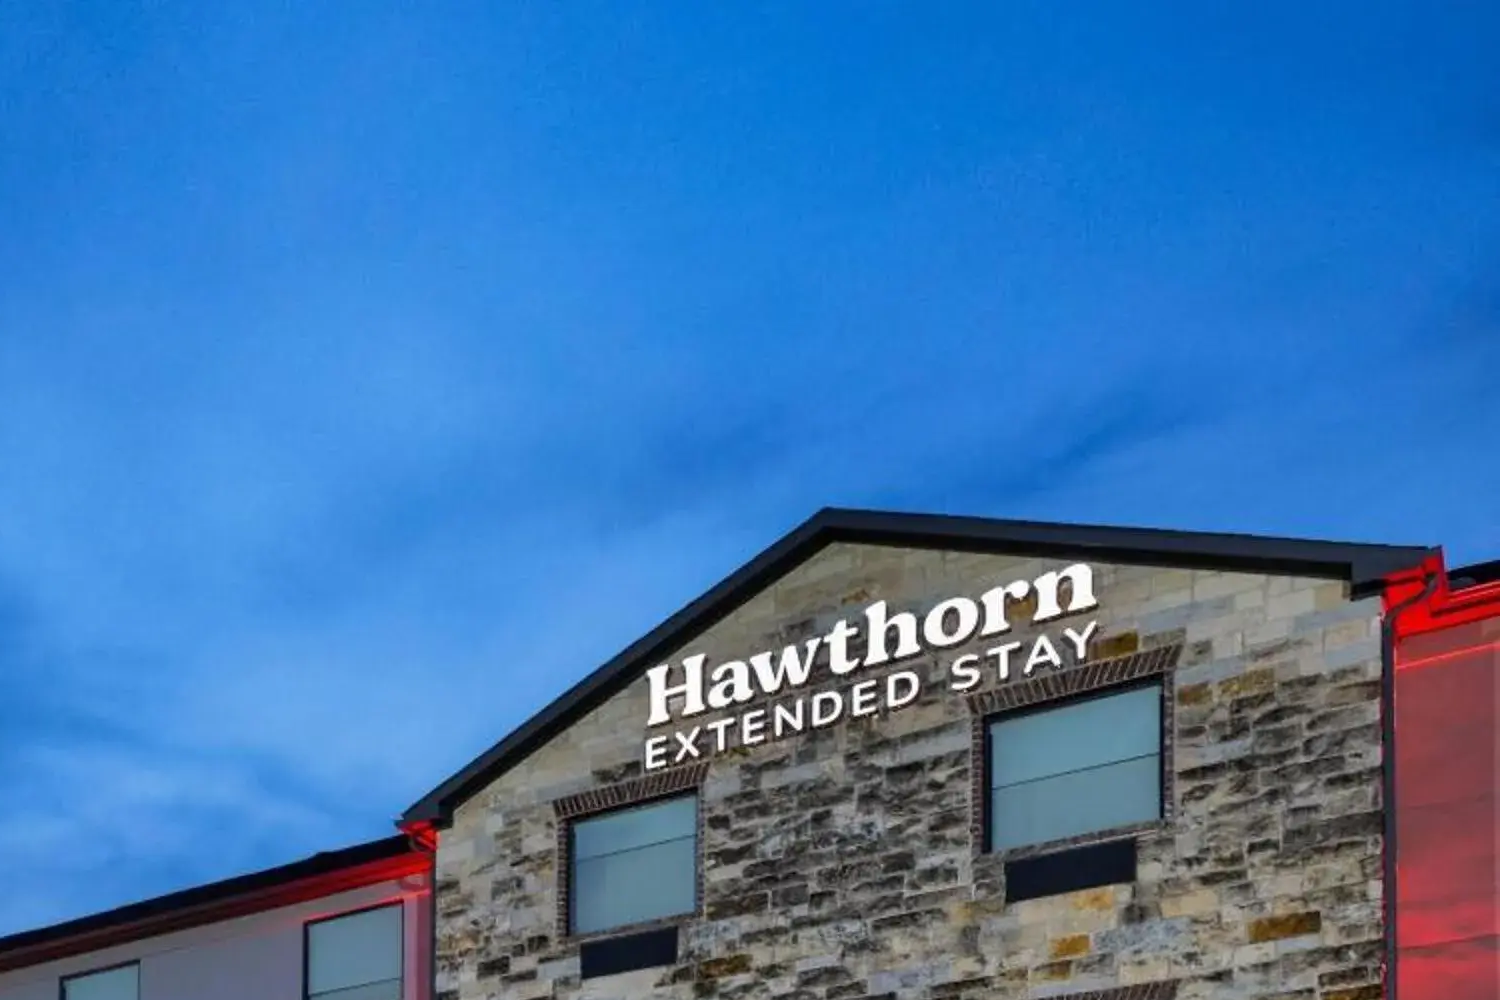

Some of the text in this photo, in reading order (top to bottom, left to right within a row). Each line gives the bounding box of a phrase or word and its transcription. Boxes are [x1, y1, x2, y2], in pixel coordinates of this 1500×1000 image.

[644, 620, 1099, 770] EXTENDED STAY
[645, 563, 1099, 728] Hawthorn
